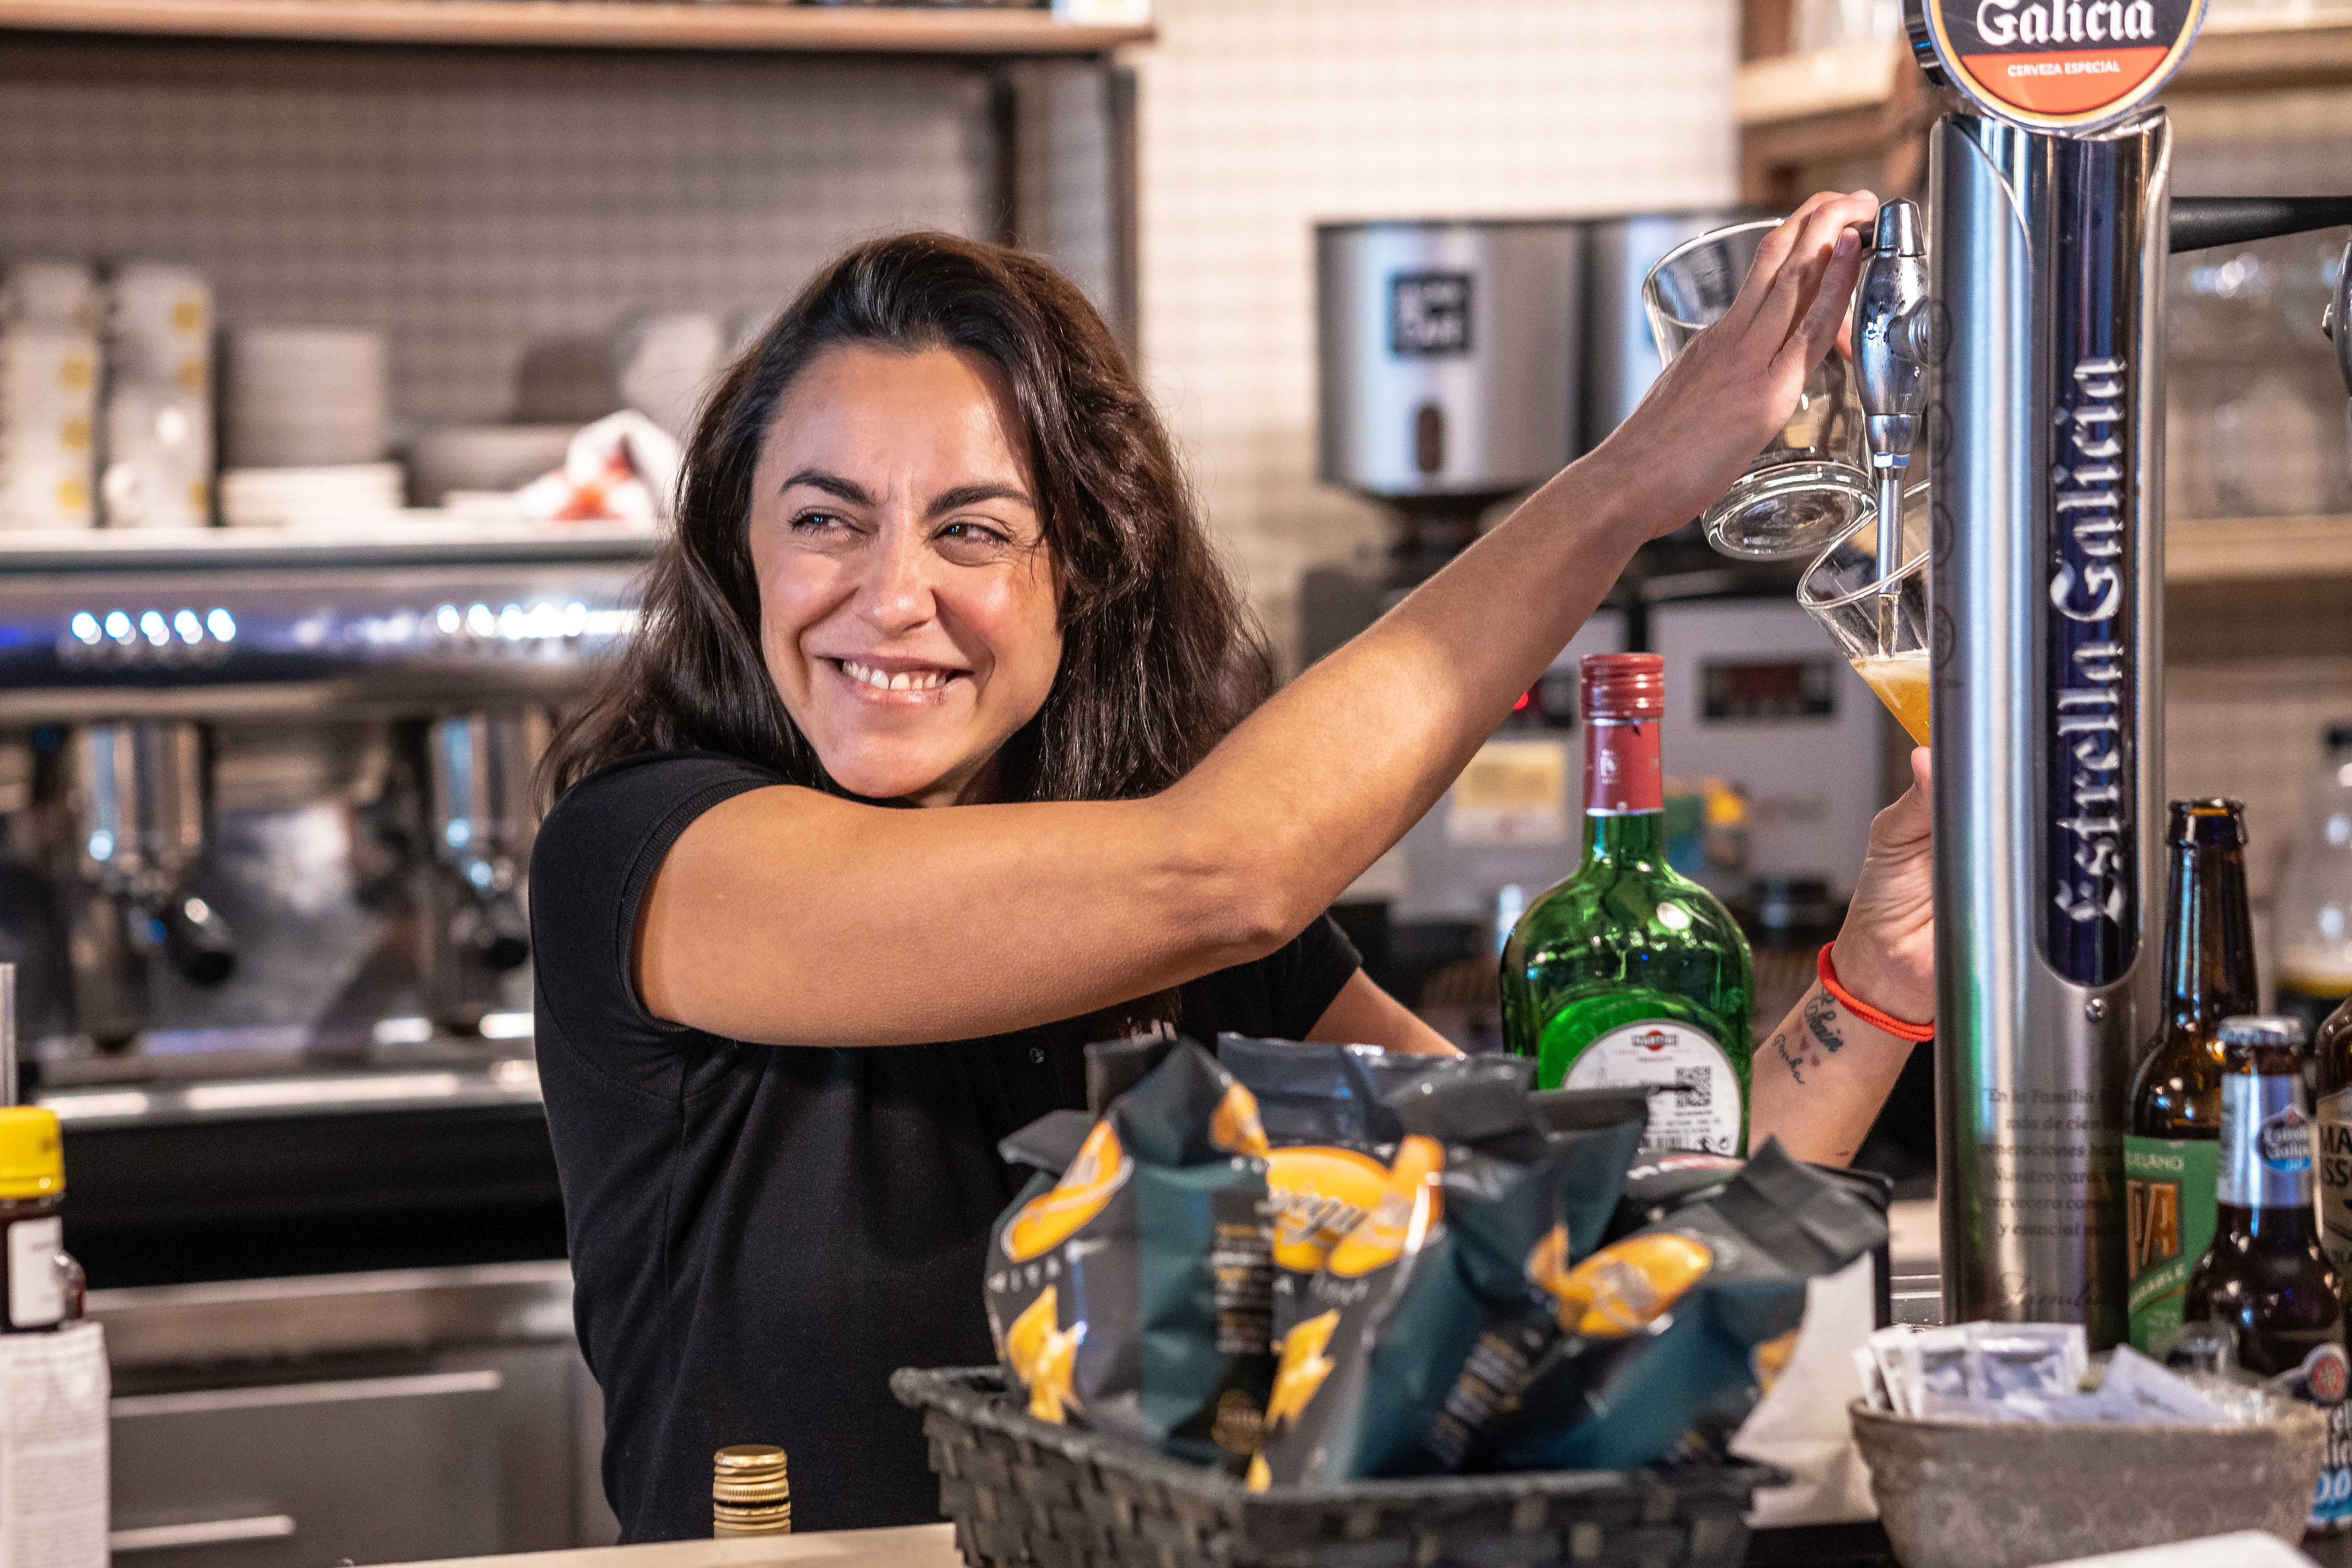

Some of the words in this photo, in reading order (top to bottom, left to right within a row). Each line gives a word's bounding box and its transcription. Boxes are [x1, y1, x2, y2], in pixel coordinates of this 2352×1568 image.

[1976, 0, 2156, 46] Galicia
[2007, 62, 2062, 77] CERVEZA
[2065, 60, 2120, 74] ESPECIAL
[2050, 356, 2127, 622] Galicia
[2053, 640, 2126, 922] Estrella
